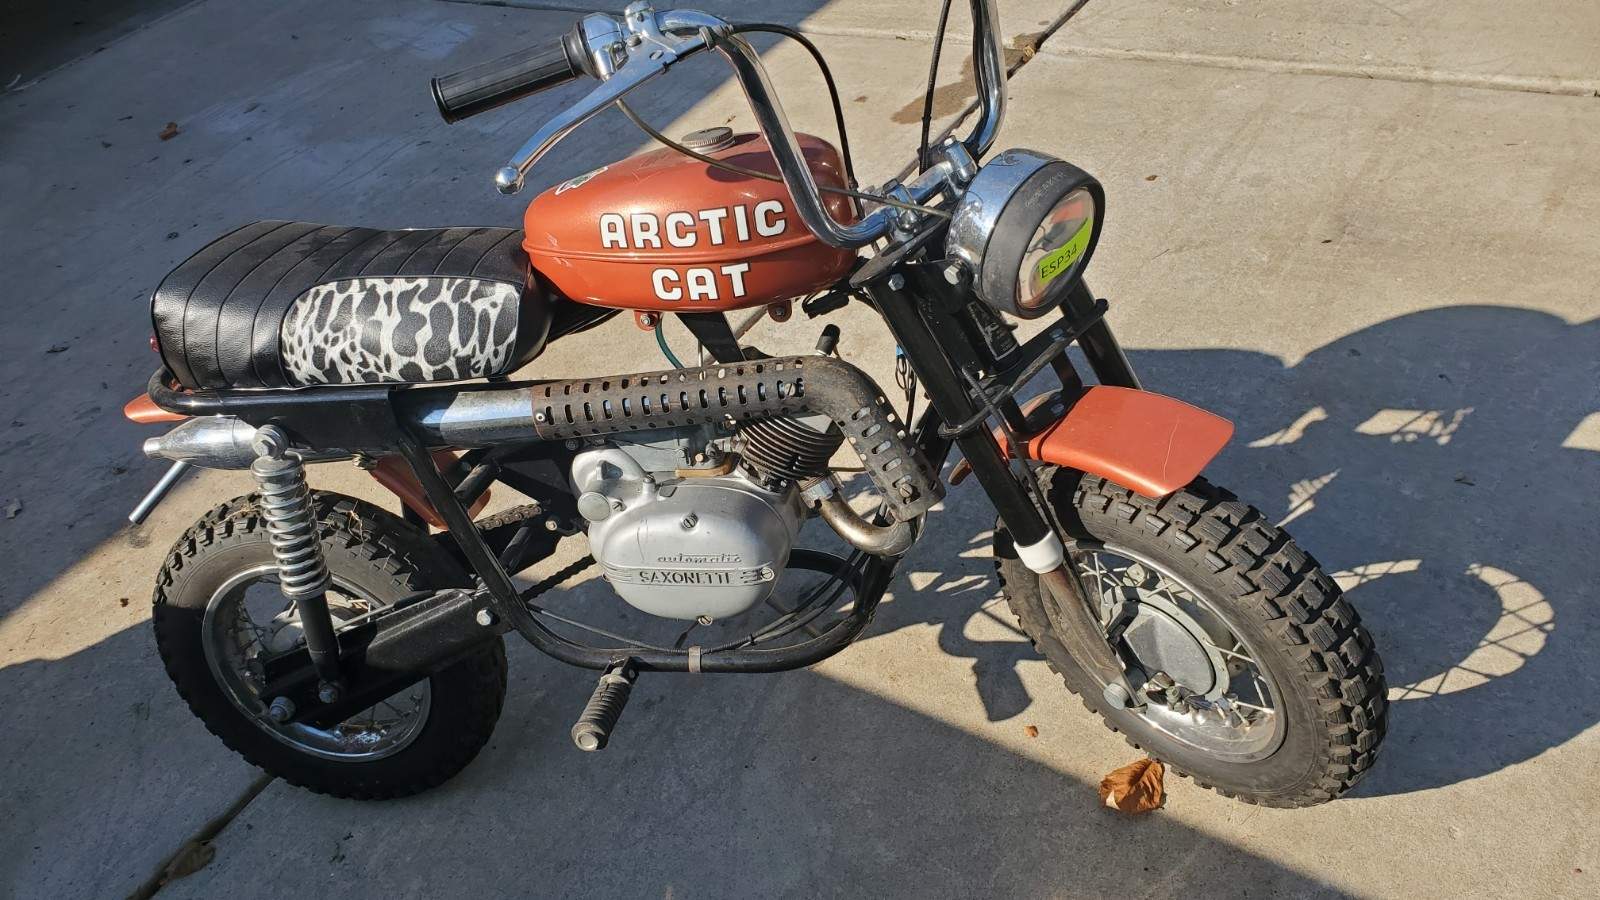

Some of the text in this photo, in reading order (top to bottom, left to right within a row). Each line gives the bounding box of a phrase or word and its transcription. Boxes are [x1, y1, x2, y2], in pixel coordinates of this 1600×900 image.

[599, 199, 788, 250] ARCTIC
[1040, 243, 1078, 279] ESP34
[651, 262, 750, 302] CAT
